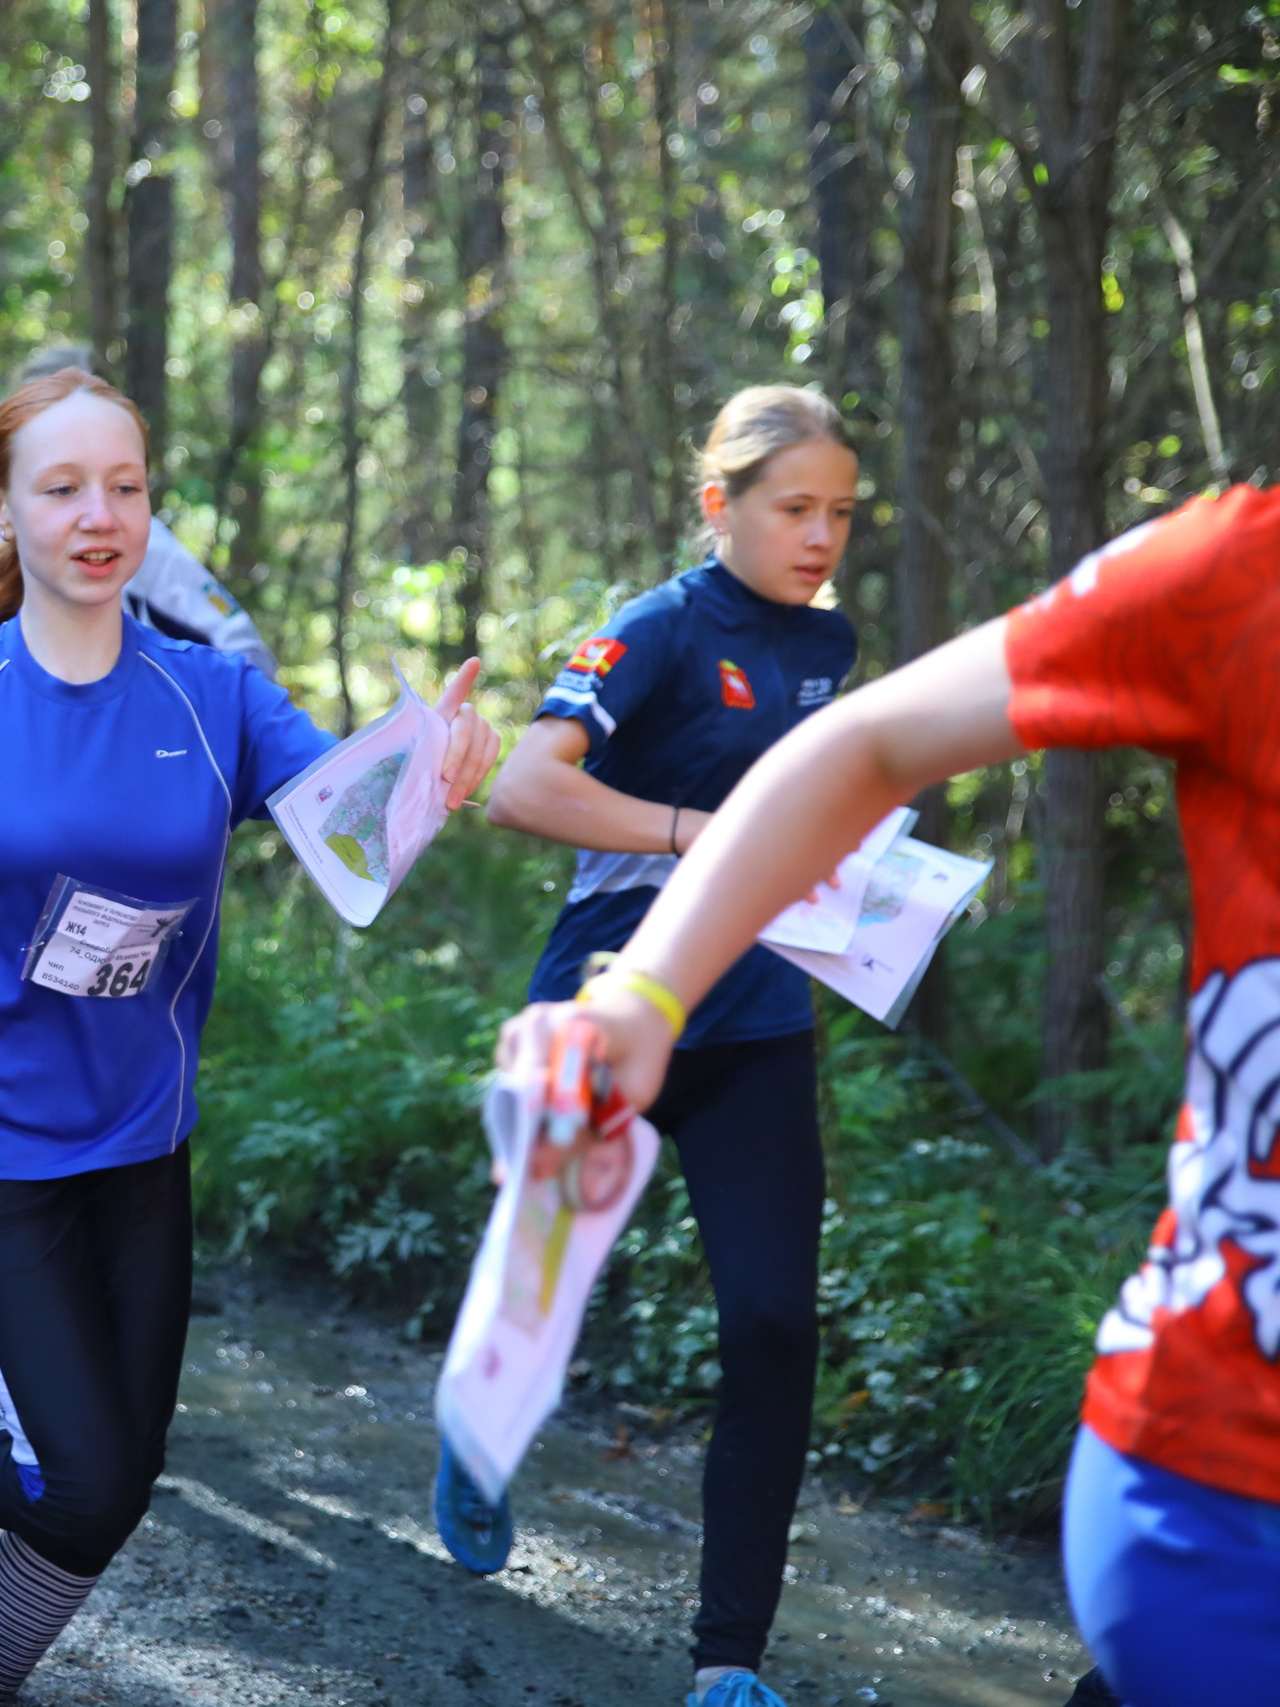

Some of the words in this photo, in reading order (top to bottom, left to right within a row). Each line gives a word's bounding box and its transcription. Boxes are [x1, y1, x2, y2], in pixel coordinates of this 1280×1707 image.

[65, 921, 87, 936] Ж14
[48, 960, 64, 971] чип
[42, 972, 80, 990] 8534140
[87, 959, 151, 997] 364
